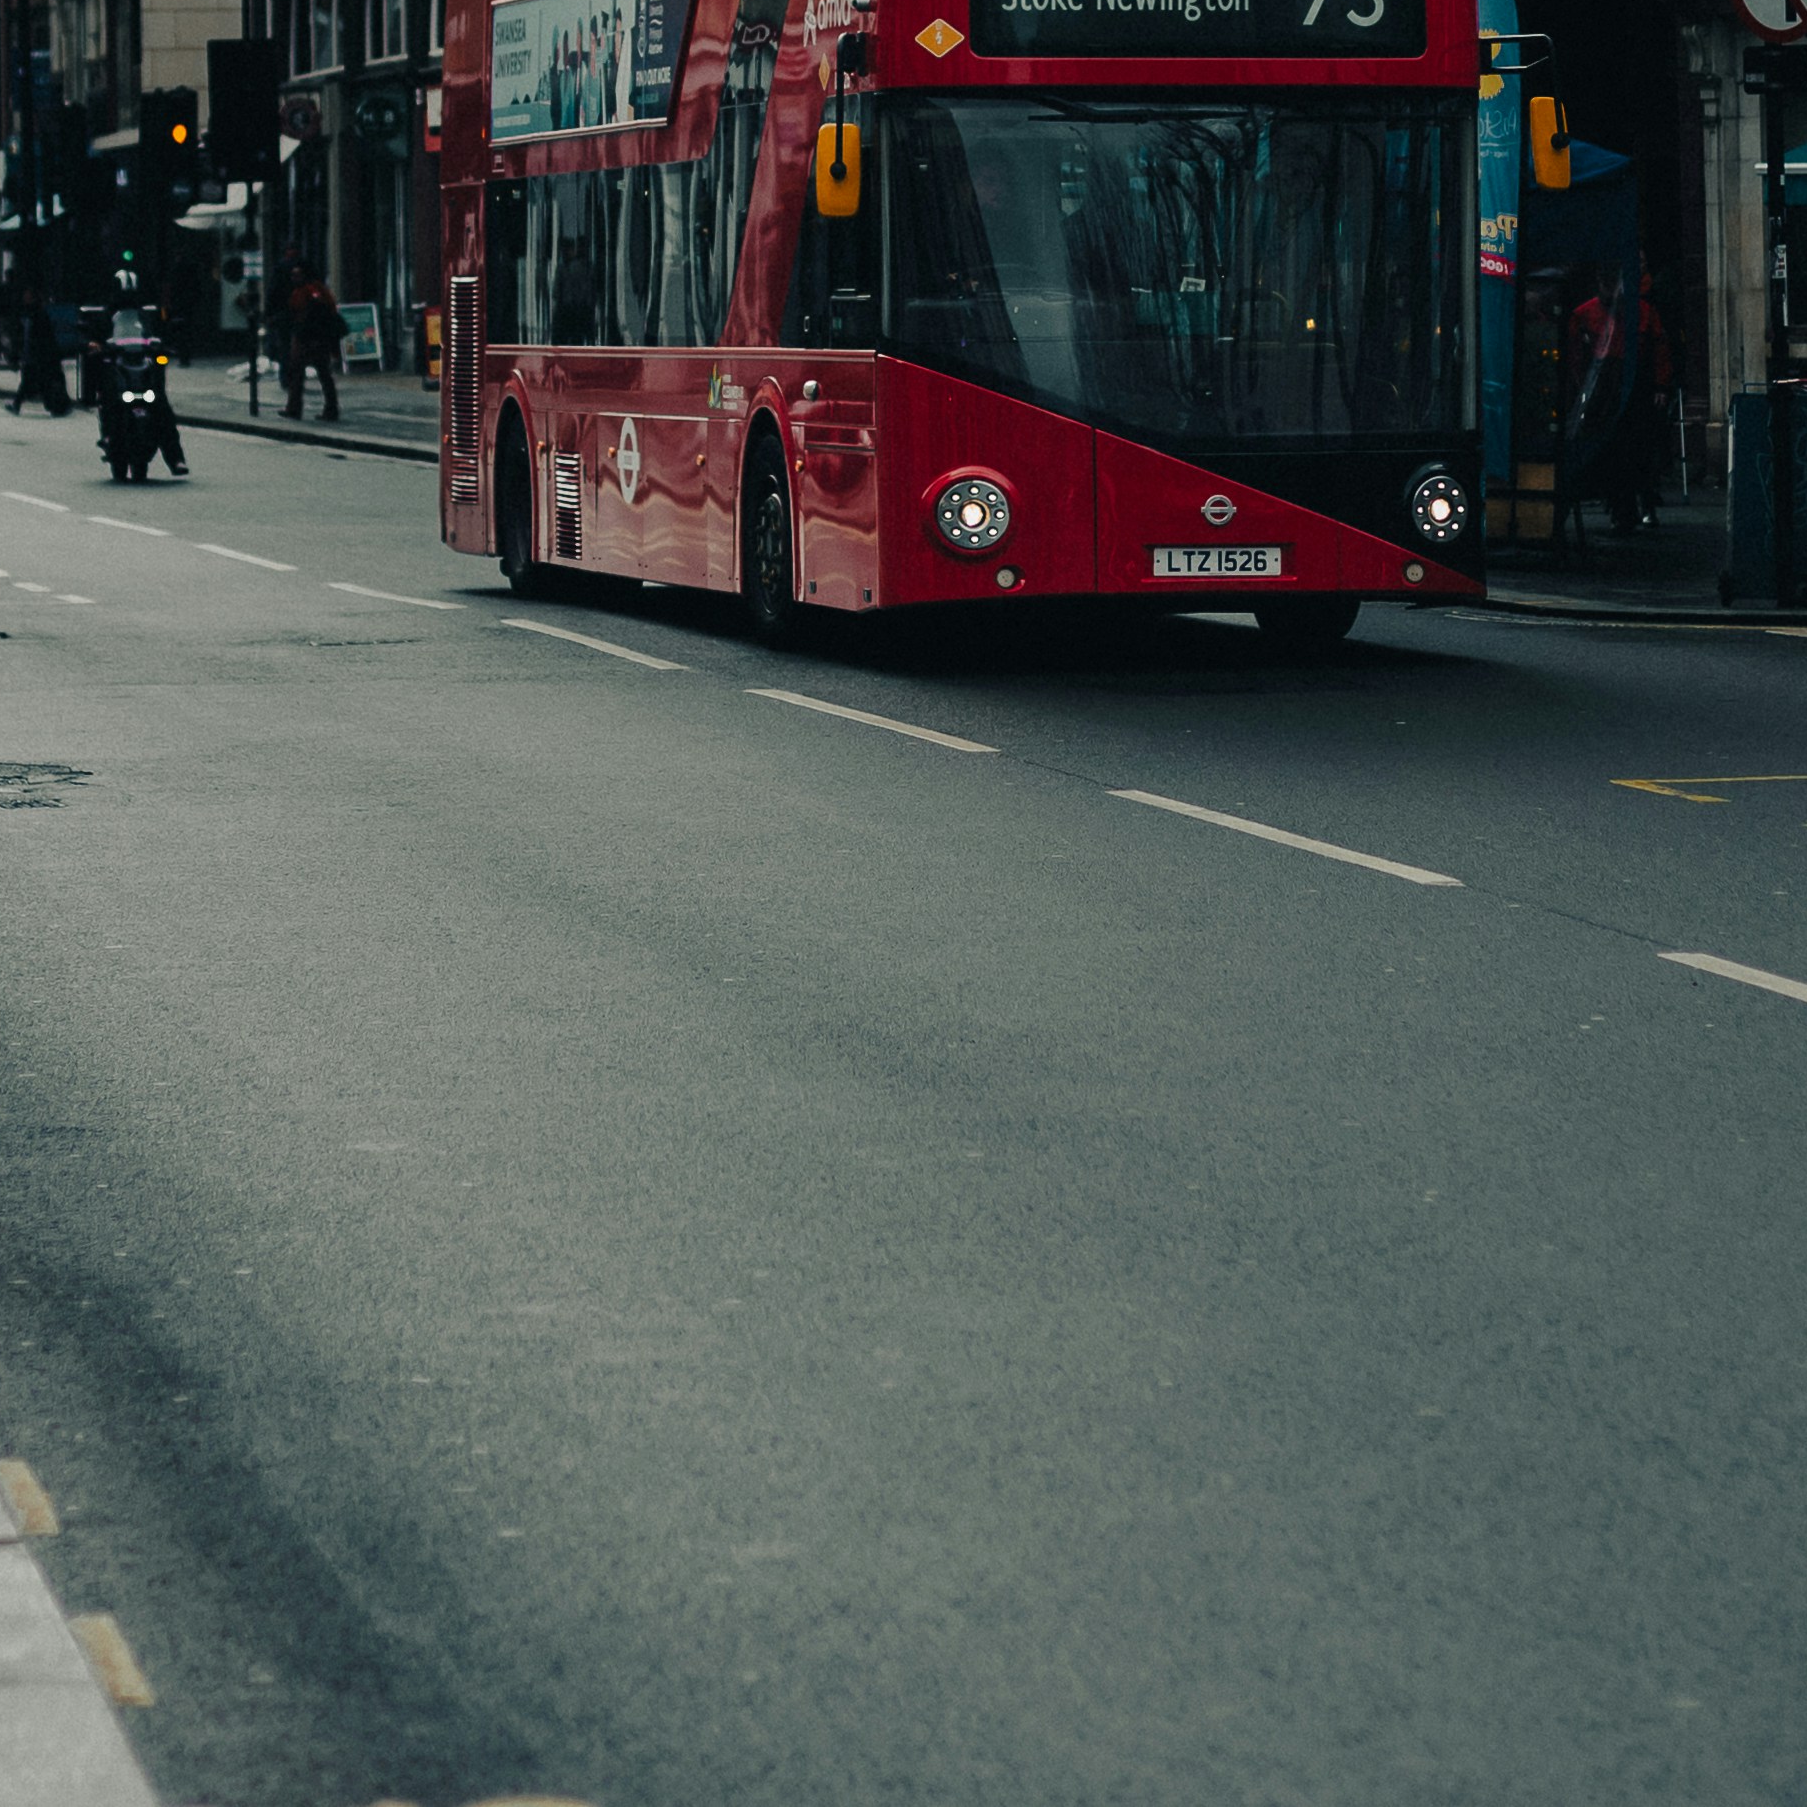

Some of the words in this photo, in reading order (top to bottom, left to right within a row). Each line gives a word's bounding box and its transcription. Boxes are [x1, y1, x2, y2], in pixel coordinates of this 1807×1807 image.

[495, 17, 527, 47] SWANSEA
[495, 49, 533, 79] UNIVERSITY
[1167, 550, 1211, 572] LTZ
[1217, 550, 1267, 572] 1526
